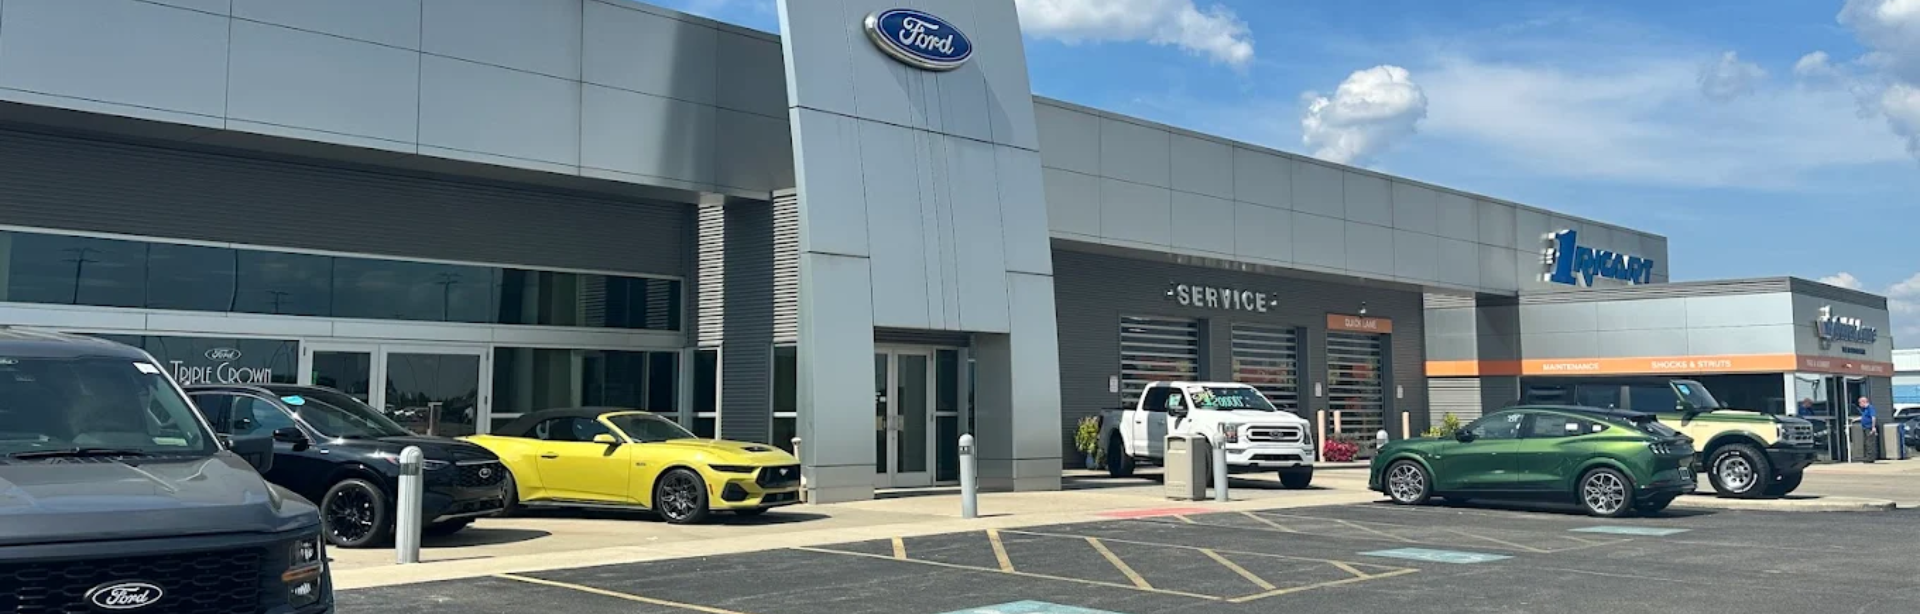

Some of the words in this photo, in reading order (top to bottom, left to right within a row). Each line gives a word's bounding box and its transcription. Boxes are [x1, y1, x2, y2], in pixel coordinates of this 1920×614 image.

[899, 16, 954, 55] Ford
[1176, 284, 1267, 312] SERVICE
[211, 349, 235, 359] Ford
[169, 360, 213, 384] TRIPLE
[216, 361, 272, 385] CROWN
[1542, 362, 1600, 371] MAINTENANCE
[1651, 360, 1688, 369] SHOCKS
[1697, 359, 1732, 368] STRUTS
[105, 587, 150, 605] Ford
